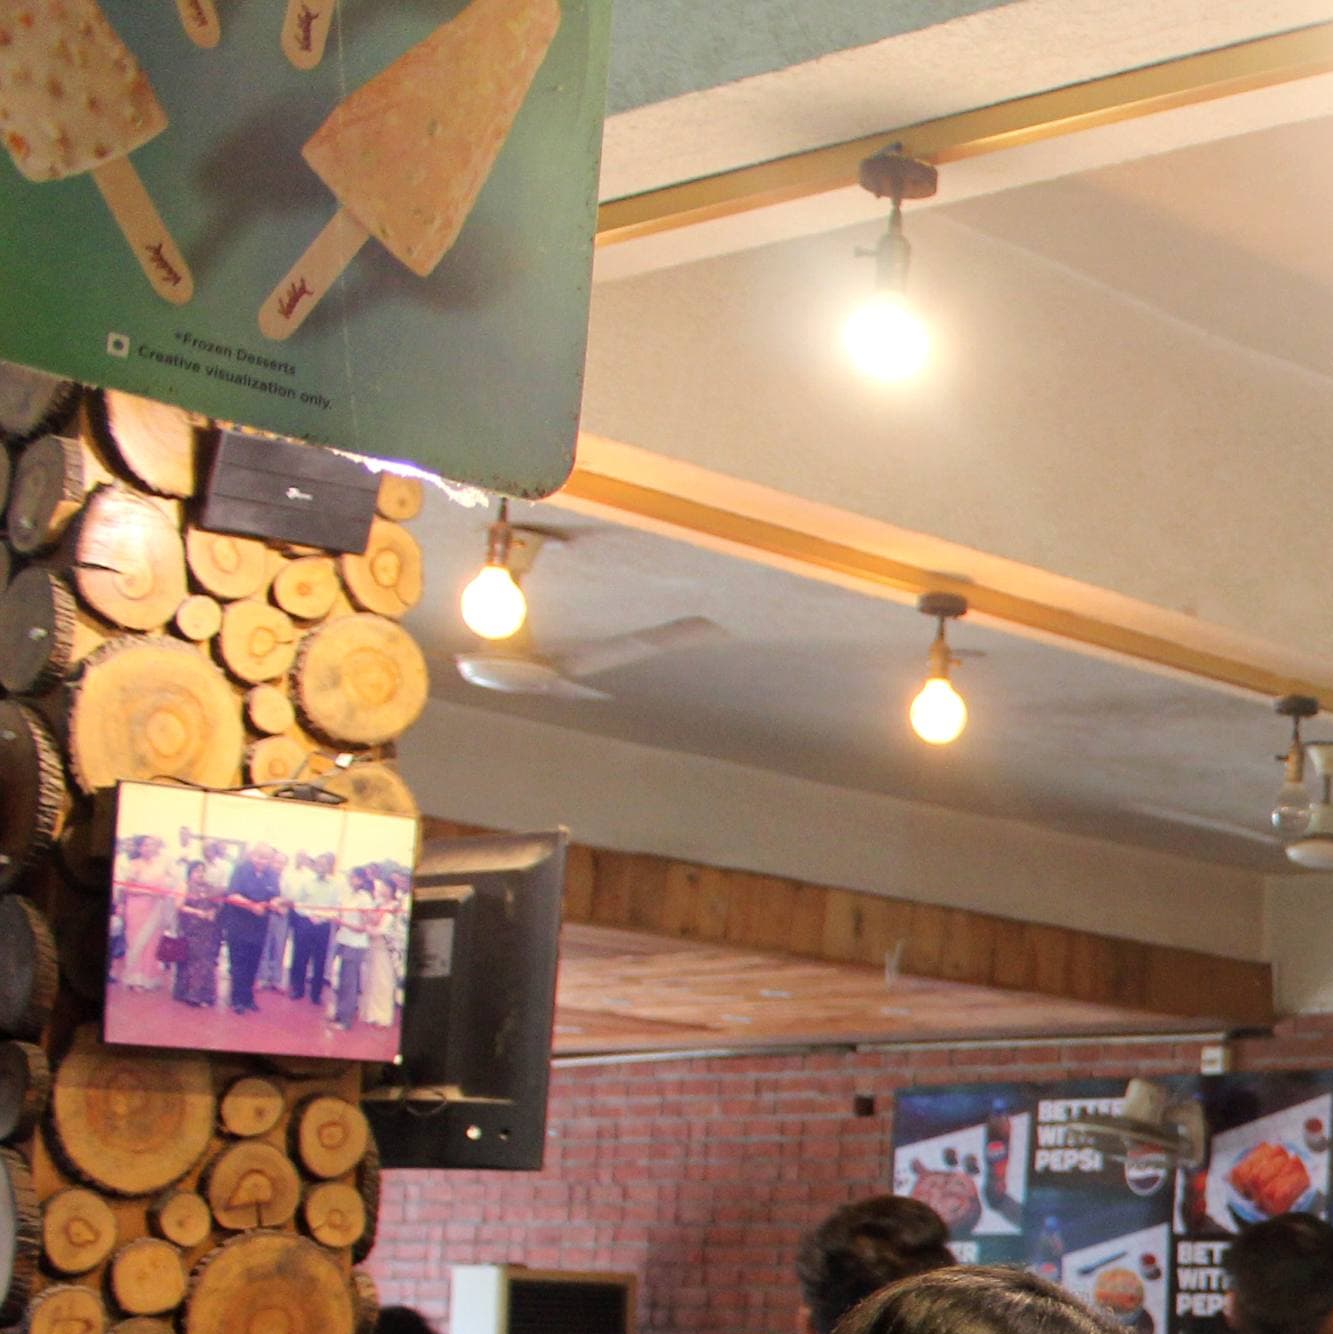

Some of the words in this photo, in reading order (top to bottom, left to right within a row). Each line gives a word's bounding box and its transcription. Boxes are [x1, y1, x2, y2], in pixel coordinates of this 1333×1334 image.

[138, 343, 200, 373] Creative
[206, 364, 297, 400] visualization
[236, 349, 297, 376] Desserts
[1035, 1148, 1104, 1172] PEPSI
[1177, 1241, 1232, 1265] BET
[1176, 1293, 1225, 1317] PEP
